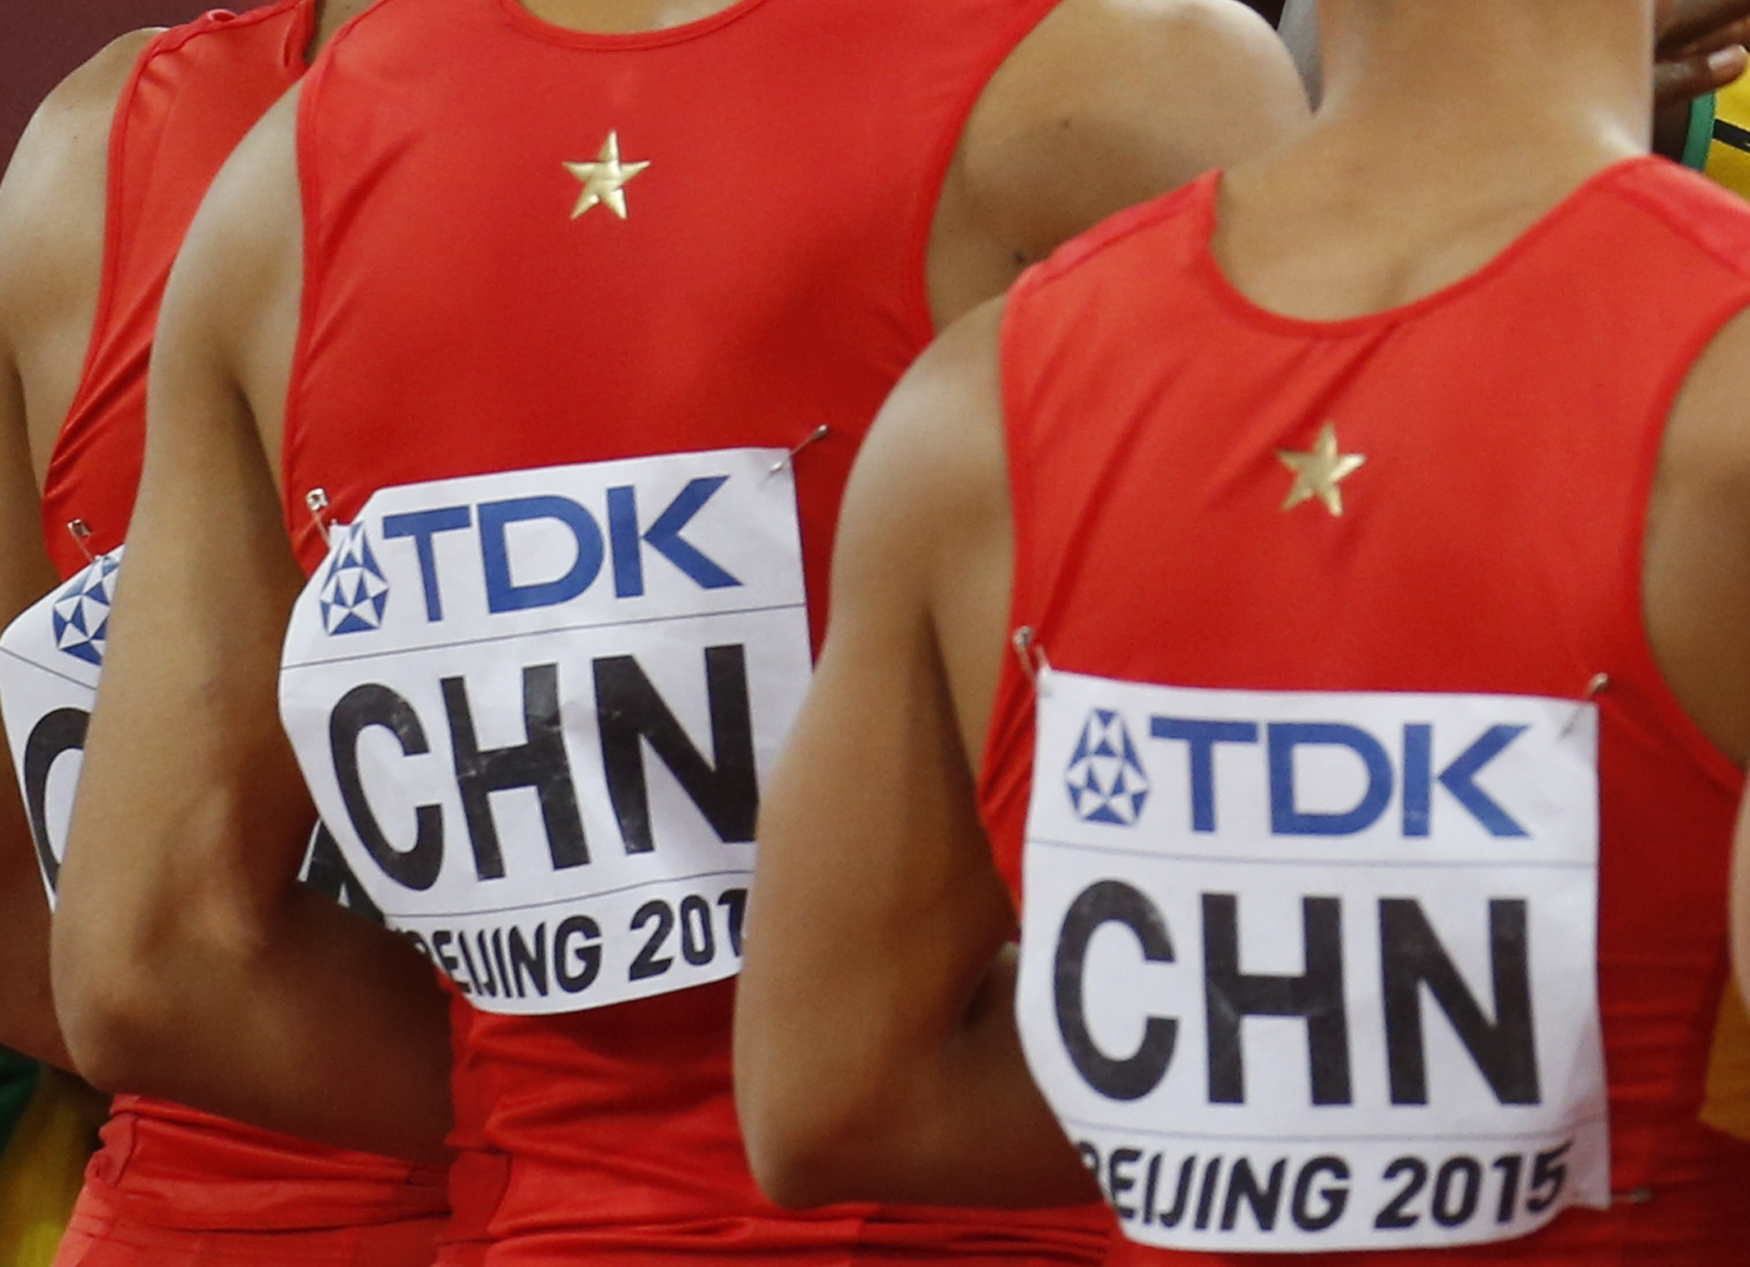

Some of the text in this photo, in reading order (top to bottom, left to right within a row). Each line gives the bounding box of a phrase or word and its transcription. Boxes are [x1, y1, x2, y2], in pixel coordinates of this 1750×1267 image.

[383, 475, 743, 622] TDK
[328, 643, 760, 892] CHN
[1148, 715, 1533, 839] TDK
[1053, 878, 1542, 1106] CHN
[1373, 1139, 1574, 1230] 2015
